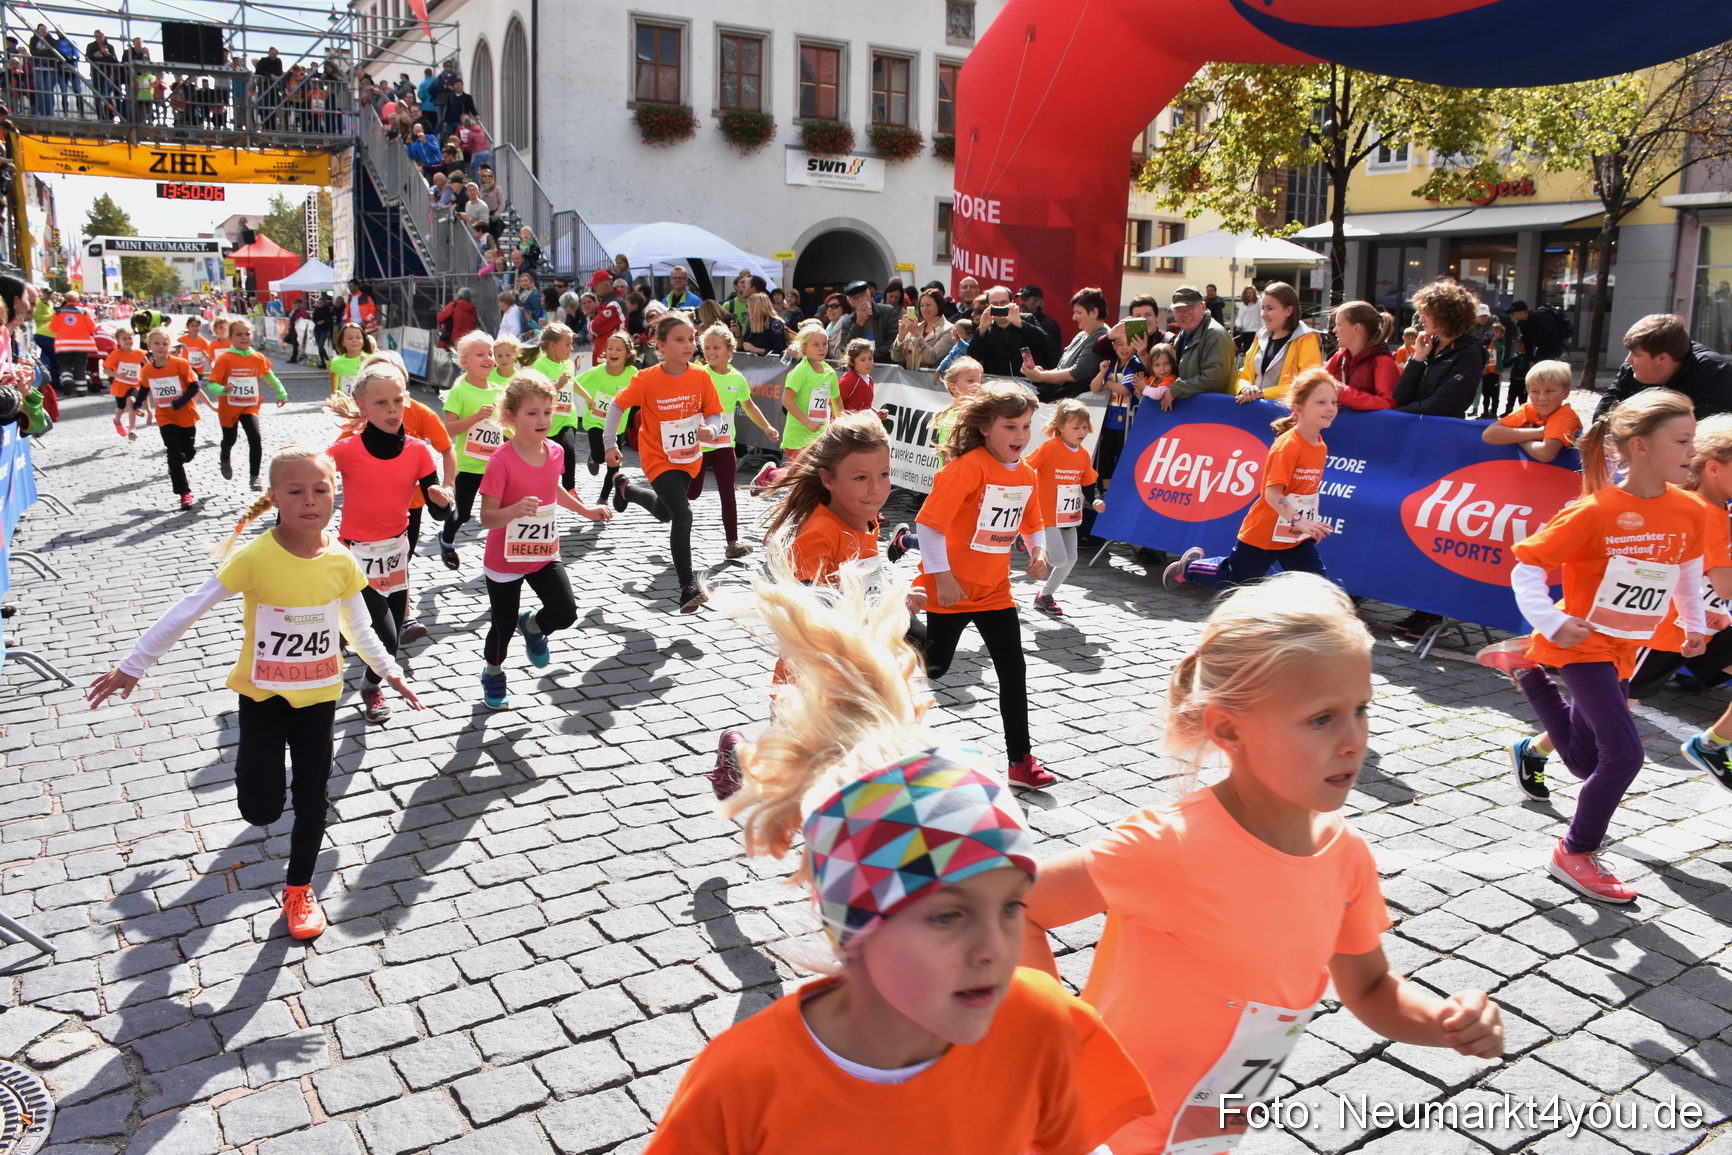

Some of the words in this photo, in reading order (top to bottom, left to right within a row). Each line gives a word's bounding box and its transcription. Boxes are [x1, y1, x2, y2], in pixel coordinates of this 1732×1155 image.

[149, 151, 219, 176] ZIEL
[807, 158, 847, 174] swn
[115, 240, 142, 250] MINI
[145, 241, 209, 252] NEUMARKT.
[154, 386, 177, 396] 7269
[233, 385, 254, 395] 7154
[656, 395, 691, 405] Neumarkter
[658, 402, 685, 411] Stadtlauf
[475, 428, 501, 445] 7036
[1143, 437, 1259, 503] Hervis
[1326, 455, 1367, 474] TORE
[1148, 488, 1193, 506] SPORTS
[1318, 480, 1357, 499] LINE
[1605, 532, 1667, 545] Neumarkter
[1431, 536, 1503, 565] SPORTS
[1605, 544, 1656, 555] Stadtlauf
[1611, 582, 1667, 611] 7207
[294, 612, 325, 622] BOCK
[270, 628, 331, 658] 7245
[256, 662, 335, 681] MADLEN
